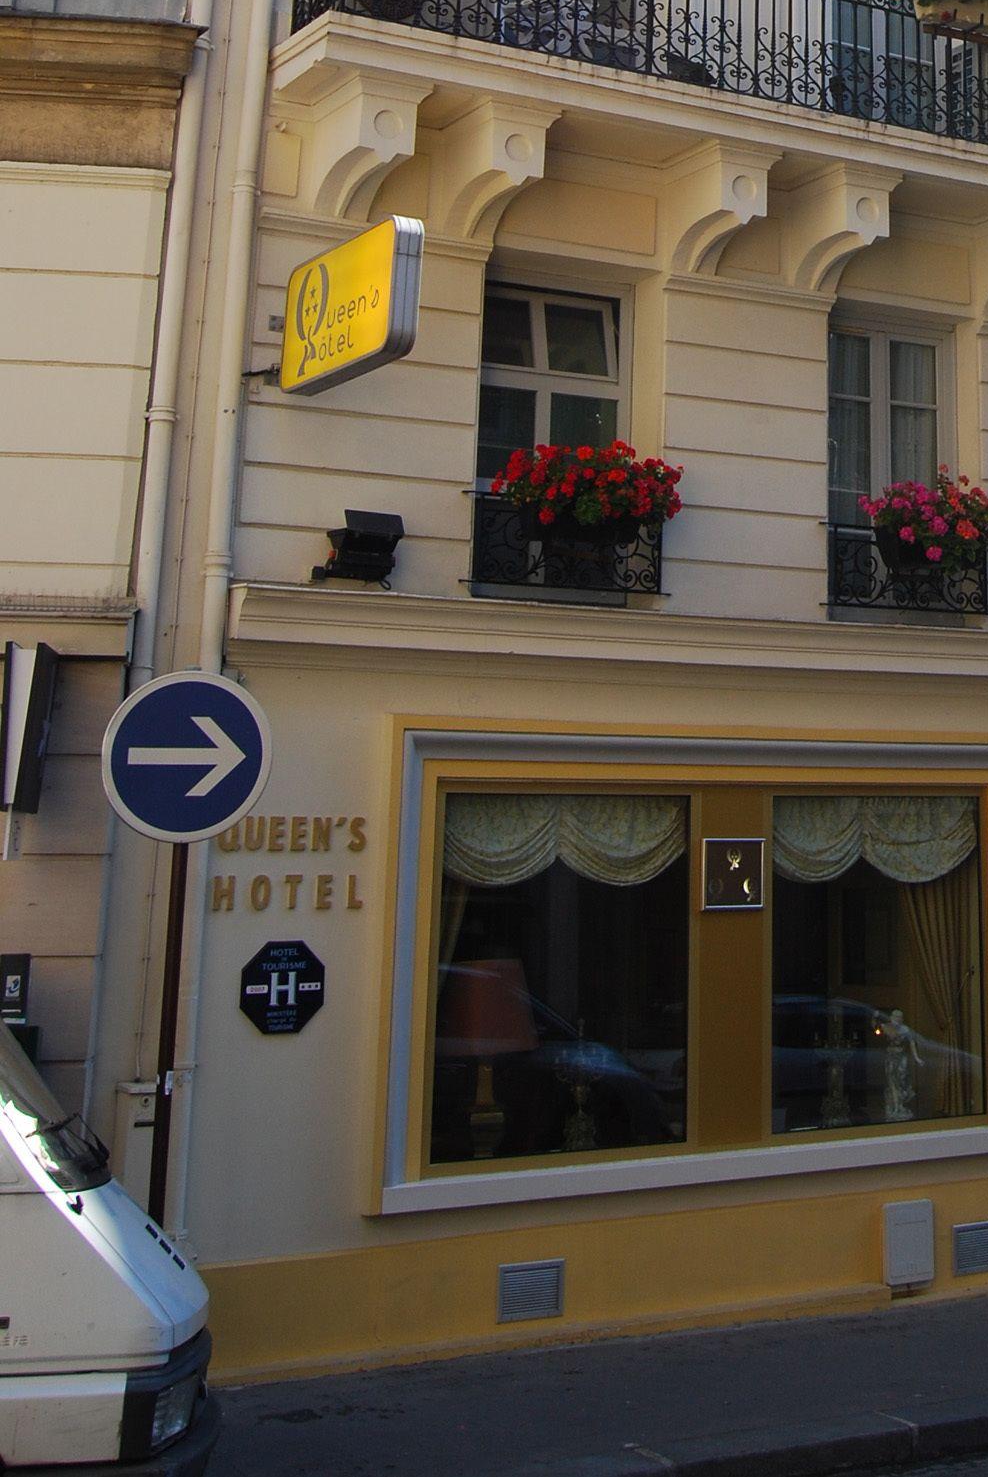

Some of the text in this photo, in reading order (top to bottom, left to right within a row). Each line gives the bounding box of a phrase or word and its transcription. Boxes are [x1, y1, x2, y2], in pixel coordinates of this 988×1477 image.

[297, 263, 380, 341] Queen's
[212, 874, 364, 912] HOTEL
[262, 961, 307, 971] TOURISME
[270, 947, 300, 957] HOTEL
[269, 971, 298, 1006] H
